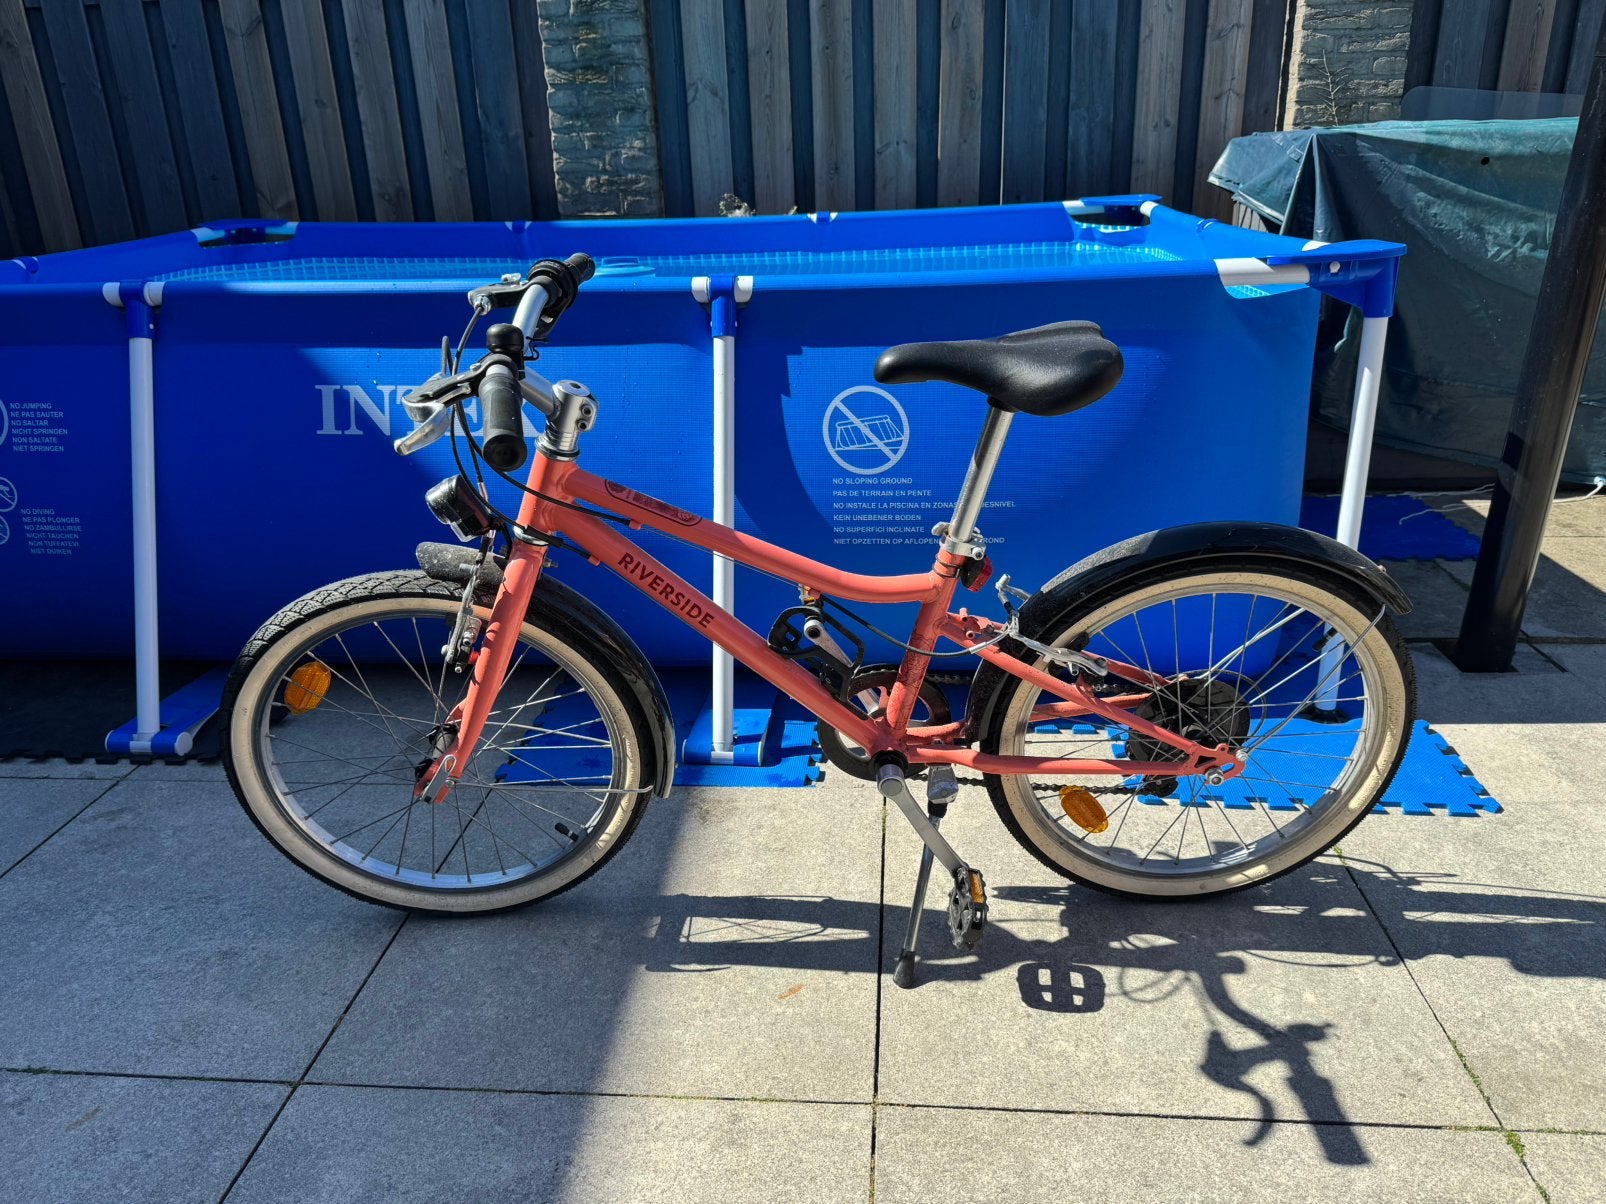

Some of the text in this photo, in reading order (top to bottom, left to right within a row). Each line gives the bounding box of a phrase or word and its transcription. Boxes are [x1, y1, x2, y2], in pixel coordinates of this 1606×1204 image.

[832, 477, 913, 485] NO SLOPING GROUND
[895, 489, 906, 497] EN
[617, 552, 715, 629] RIVERSIDE
